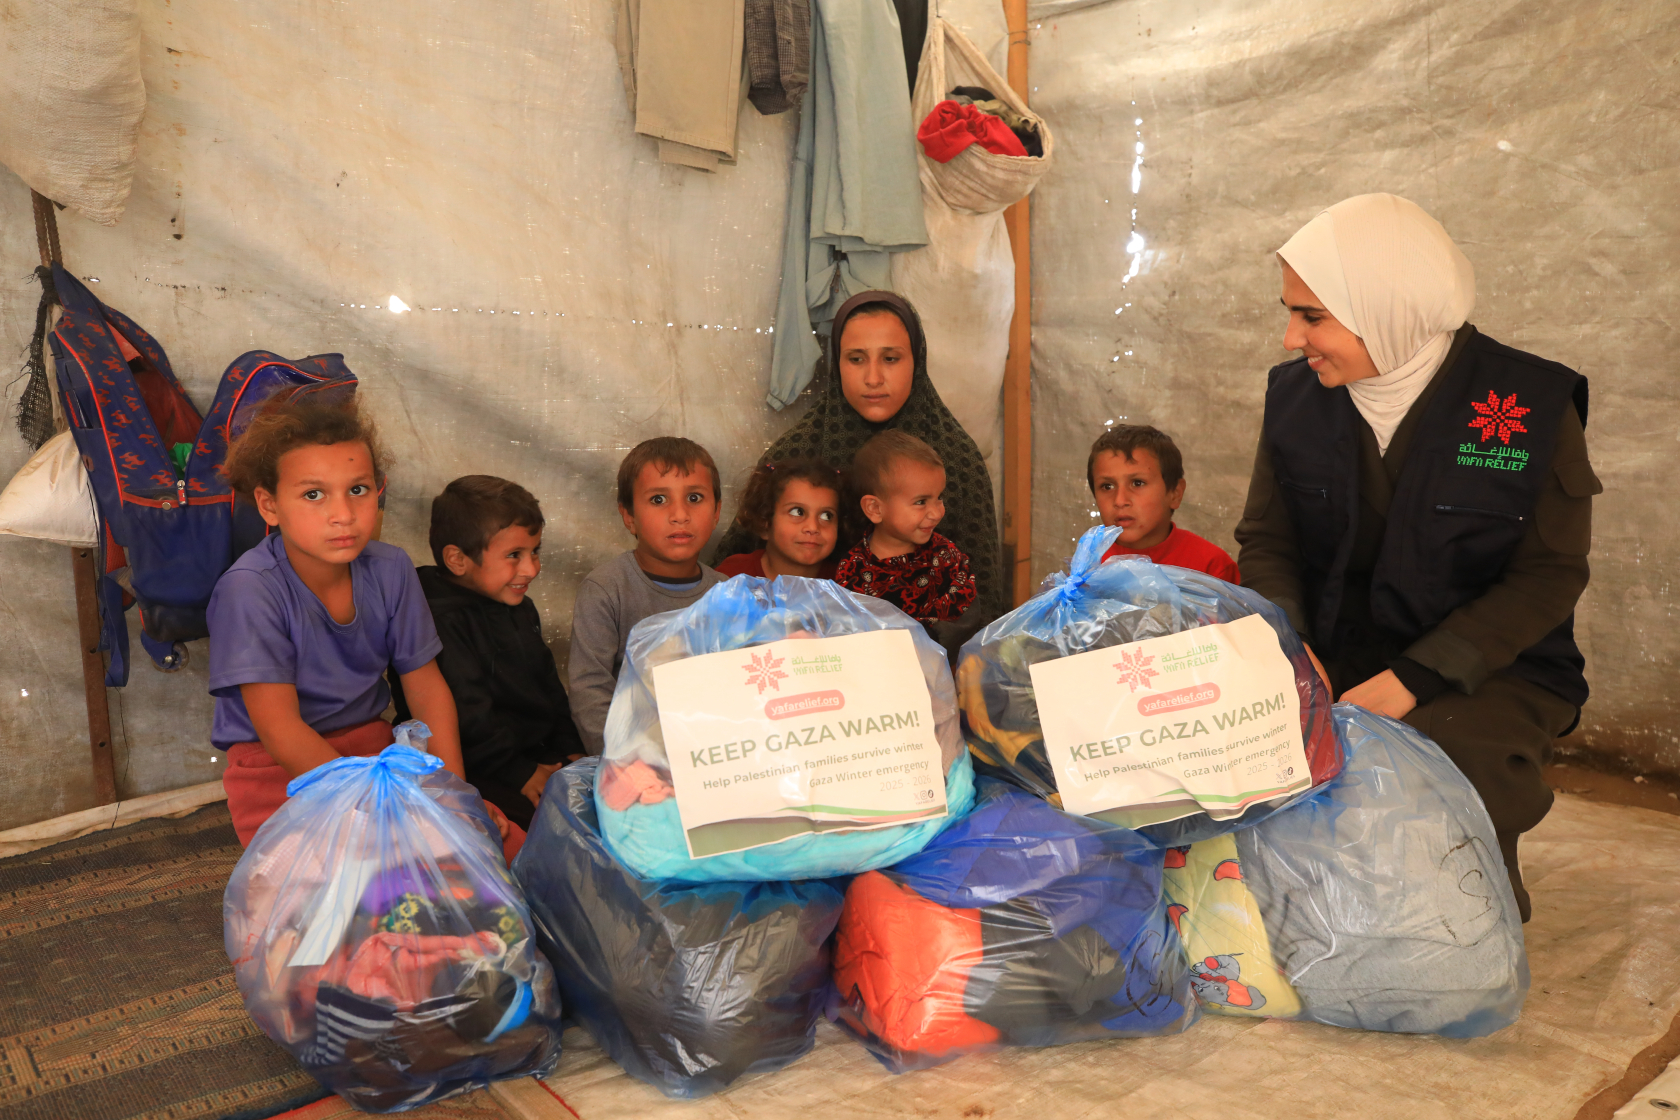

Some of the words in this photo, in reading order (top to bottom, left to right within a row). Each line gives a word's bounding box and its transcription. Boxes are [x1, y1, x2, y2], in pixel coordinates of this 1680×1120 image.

[1485, 458, 1527, 471] RELIEF
[815, 663, 843, 674] RELIEF
[1187, 652, 1220, 669] RELIEF
[771, 696, 840, 716] yafarelief.org
[1143, 689, 1215, 713] yafarelief.org
[689, 739, 757, 769] KEEP
[765, 724, 836, 754] GAZA
[838, 710, 921, 738] WARM!
[1069, 735, 1132, 763] KEEP
[1139, 719, 1210, 747] GAZA
[1211, 692, 1287, 731] WARM!
[1084, 767, 1111, 782] Help
[1113, 755, 1174, 774] Palestinian
[1177, 745, 1225, 762] families
[1225, 735, 1260, 752] survive
[1262, 722, 1288, 740] winter
[1183, 766, 1210, 779] Gaza
[1212, 757, 1242, 774] Winter
[1245, 739, 1291, 762] emergency
[702, 776, 731, 790] Help
[734, 764, 800, 783] Palestinian
[804, 753, 849, 770] families
[851, 746, 891, 761] survive
[893, 741, 924, 755] winter
[809, 774, 834, 788] Gaza
[835, 768, 873, 783] Winter
[876, 760, 930, 777] emergency
[1246, 762, 1268, 776] 2025
[879, 779, 904, 792] 2025
[913, 775, 932, 786] 2026
